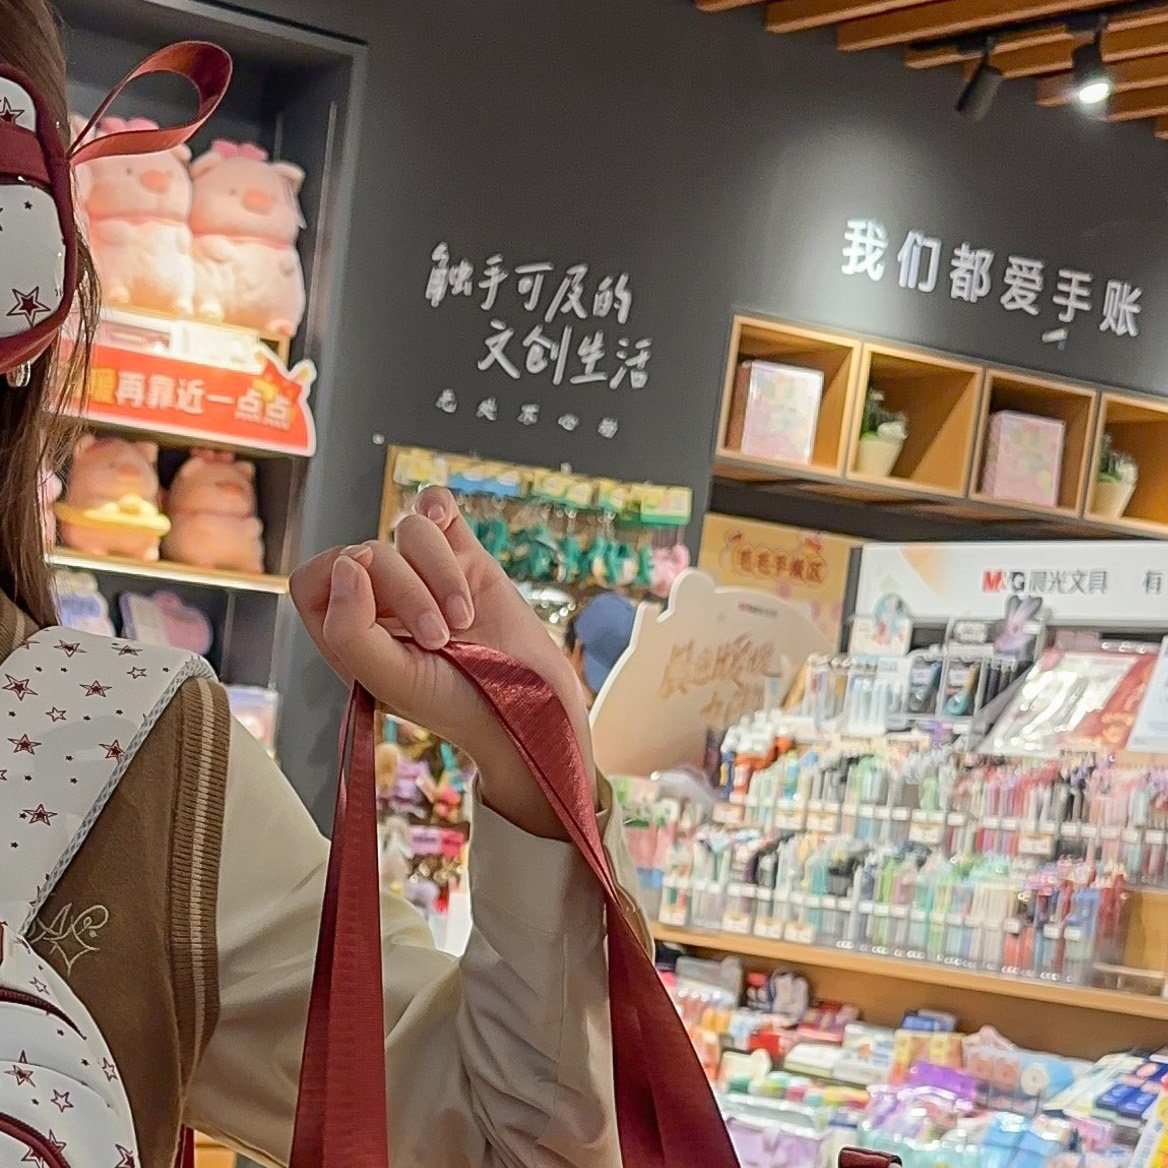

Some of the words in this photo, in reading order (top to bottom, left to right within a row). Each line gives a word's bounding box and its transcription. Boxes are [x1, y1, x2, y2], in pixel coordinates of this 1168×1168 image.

[425, 241, 633, 326] 触手可及的
[840, 218, 1143, 338] 我们都爱手账
[477, 317, 653, 390] 文创生活
